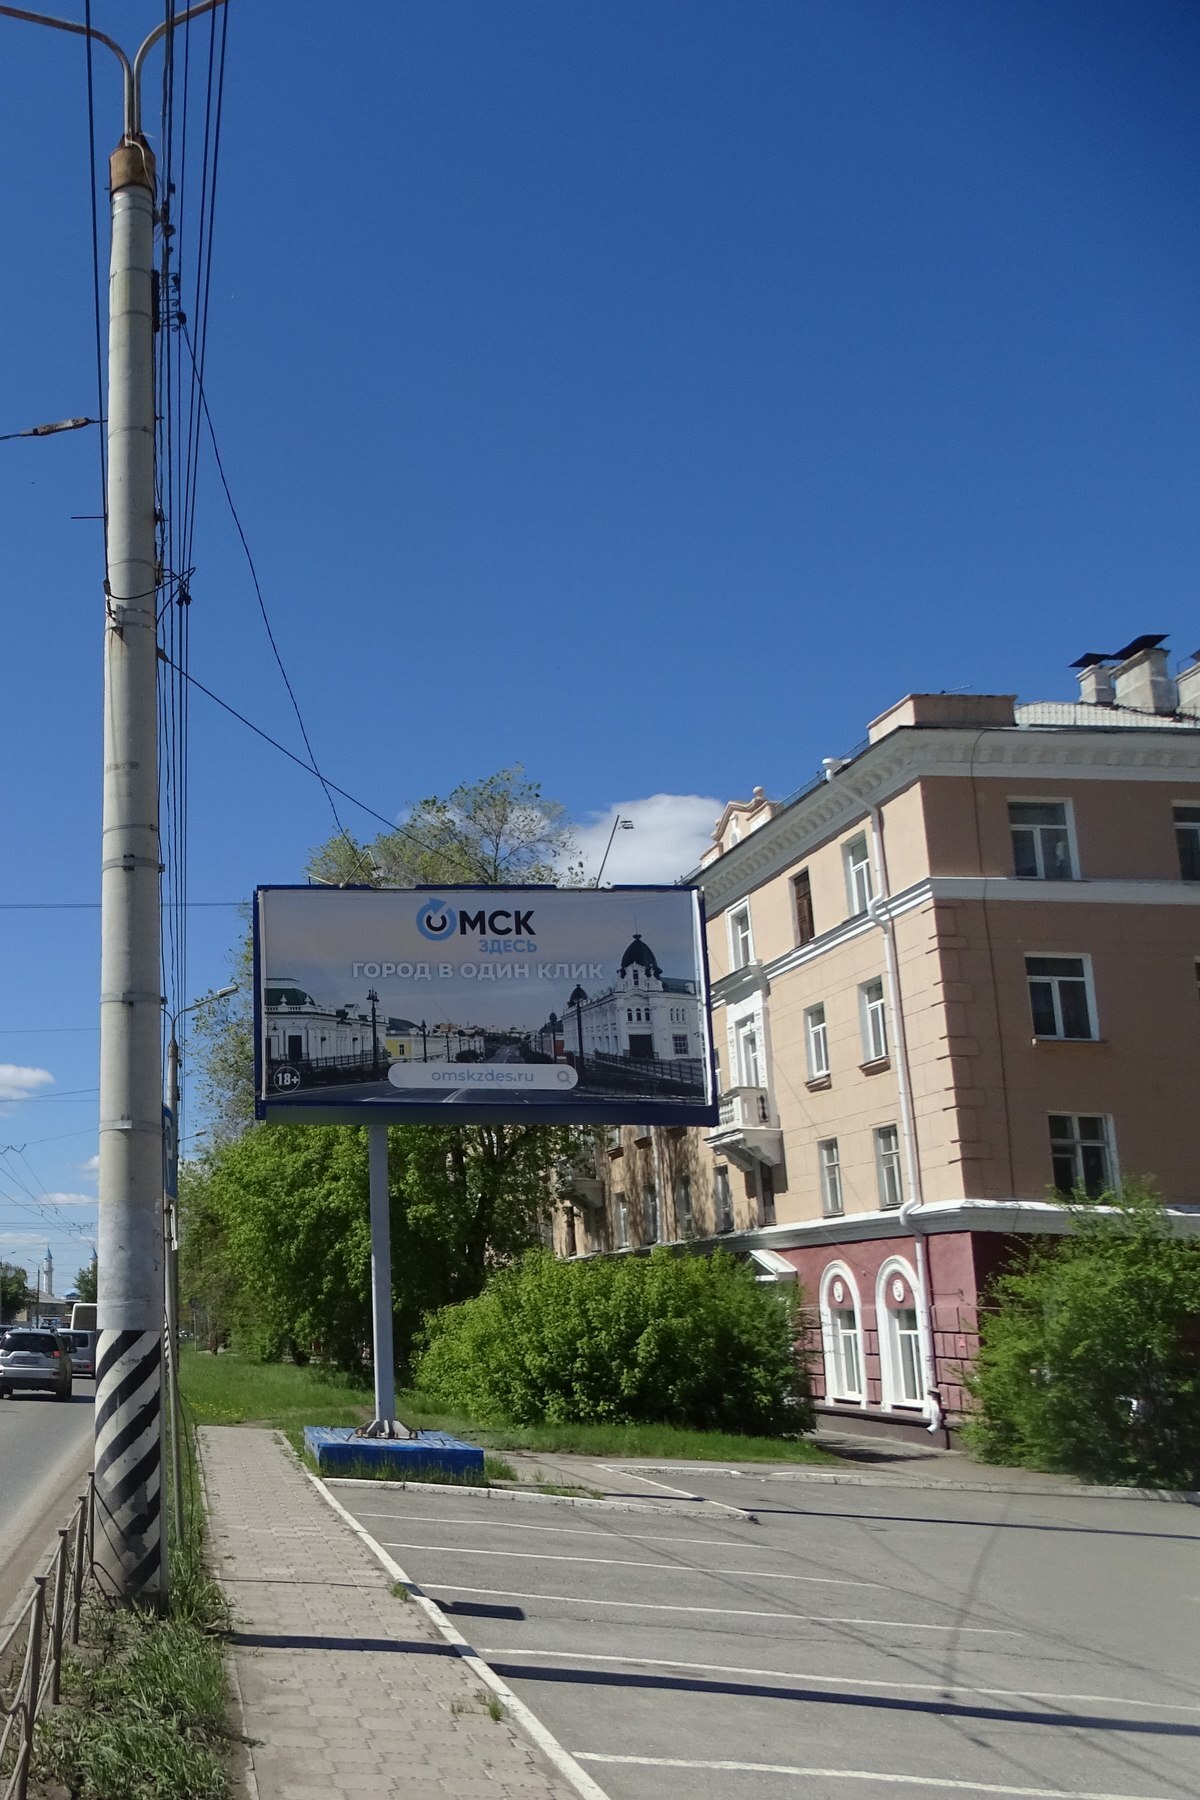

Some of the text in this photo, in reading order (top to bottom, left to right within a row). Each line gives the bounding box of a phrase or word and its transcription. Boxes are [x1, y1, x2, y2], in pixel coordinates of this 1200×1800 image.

[478, 939, 538, 955] ЗДЕСЬ
[352, 962, 604, 980] ГОРОД В ОДИН КЛИК
[277, 1073, 300, 1086] 18+
[431, 1069, 534, 1084] omskzdes.ru
